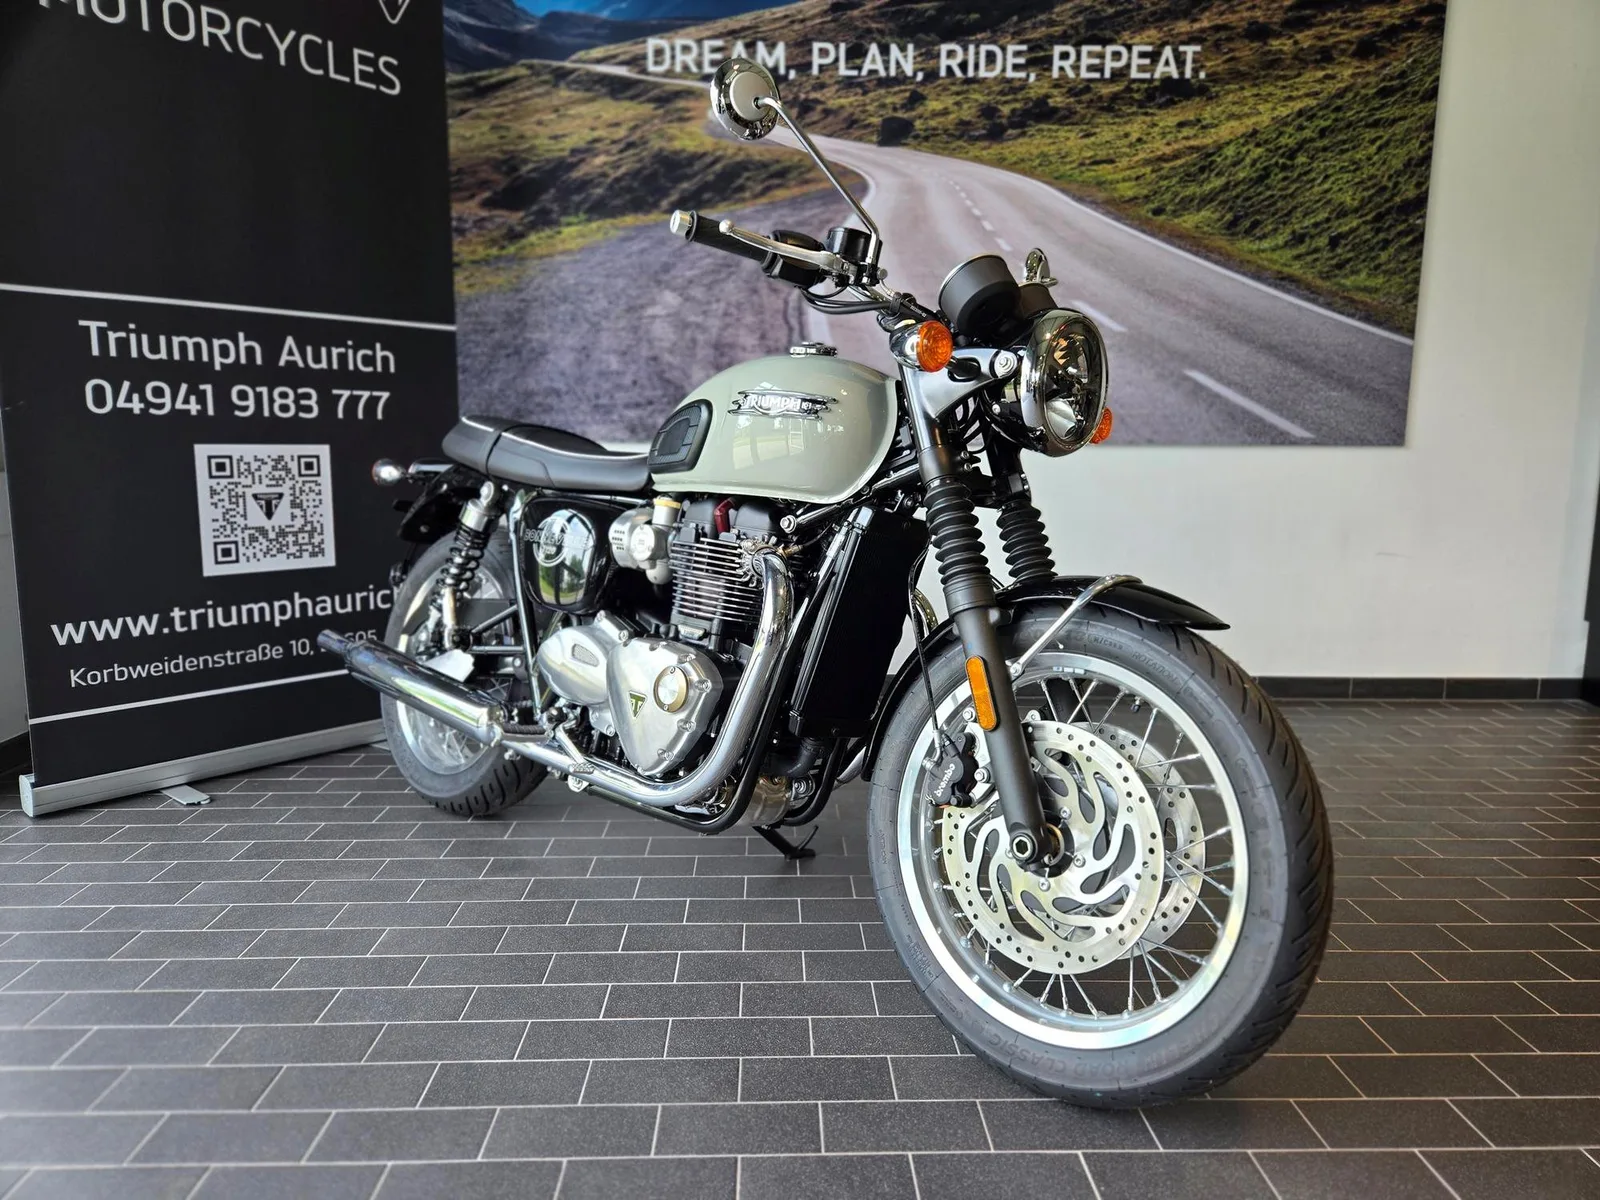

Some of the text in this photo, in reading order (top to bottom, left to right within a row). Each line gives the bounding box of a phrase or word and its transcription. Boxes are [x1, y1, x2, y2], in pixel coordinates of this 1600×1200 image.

[39, 0, 401, 95] OTORCYCLES
[811, 42, 924, 82] PLAN,
[938, 43, 1036, 82] RIDE,
[1052, 44, 1206, 80] REPEAT.
[78, 319, 395, 373] Triumph Aurich
[85, 378, 391, 420] 04941 9183 777
[742, 392, 802, 411] TRIUMPH
[69, 643, 284, 688] Korbweidenstraße
[290, 638, 314, 656] 10,
[933, 763, 956, 797] brembo
[987, 1034, 1067, 1075] CLASSIC
[1073, 1060, 1130, 1078] ROAD
